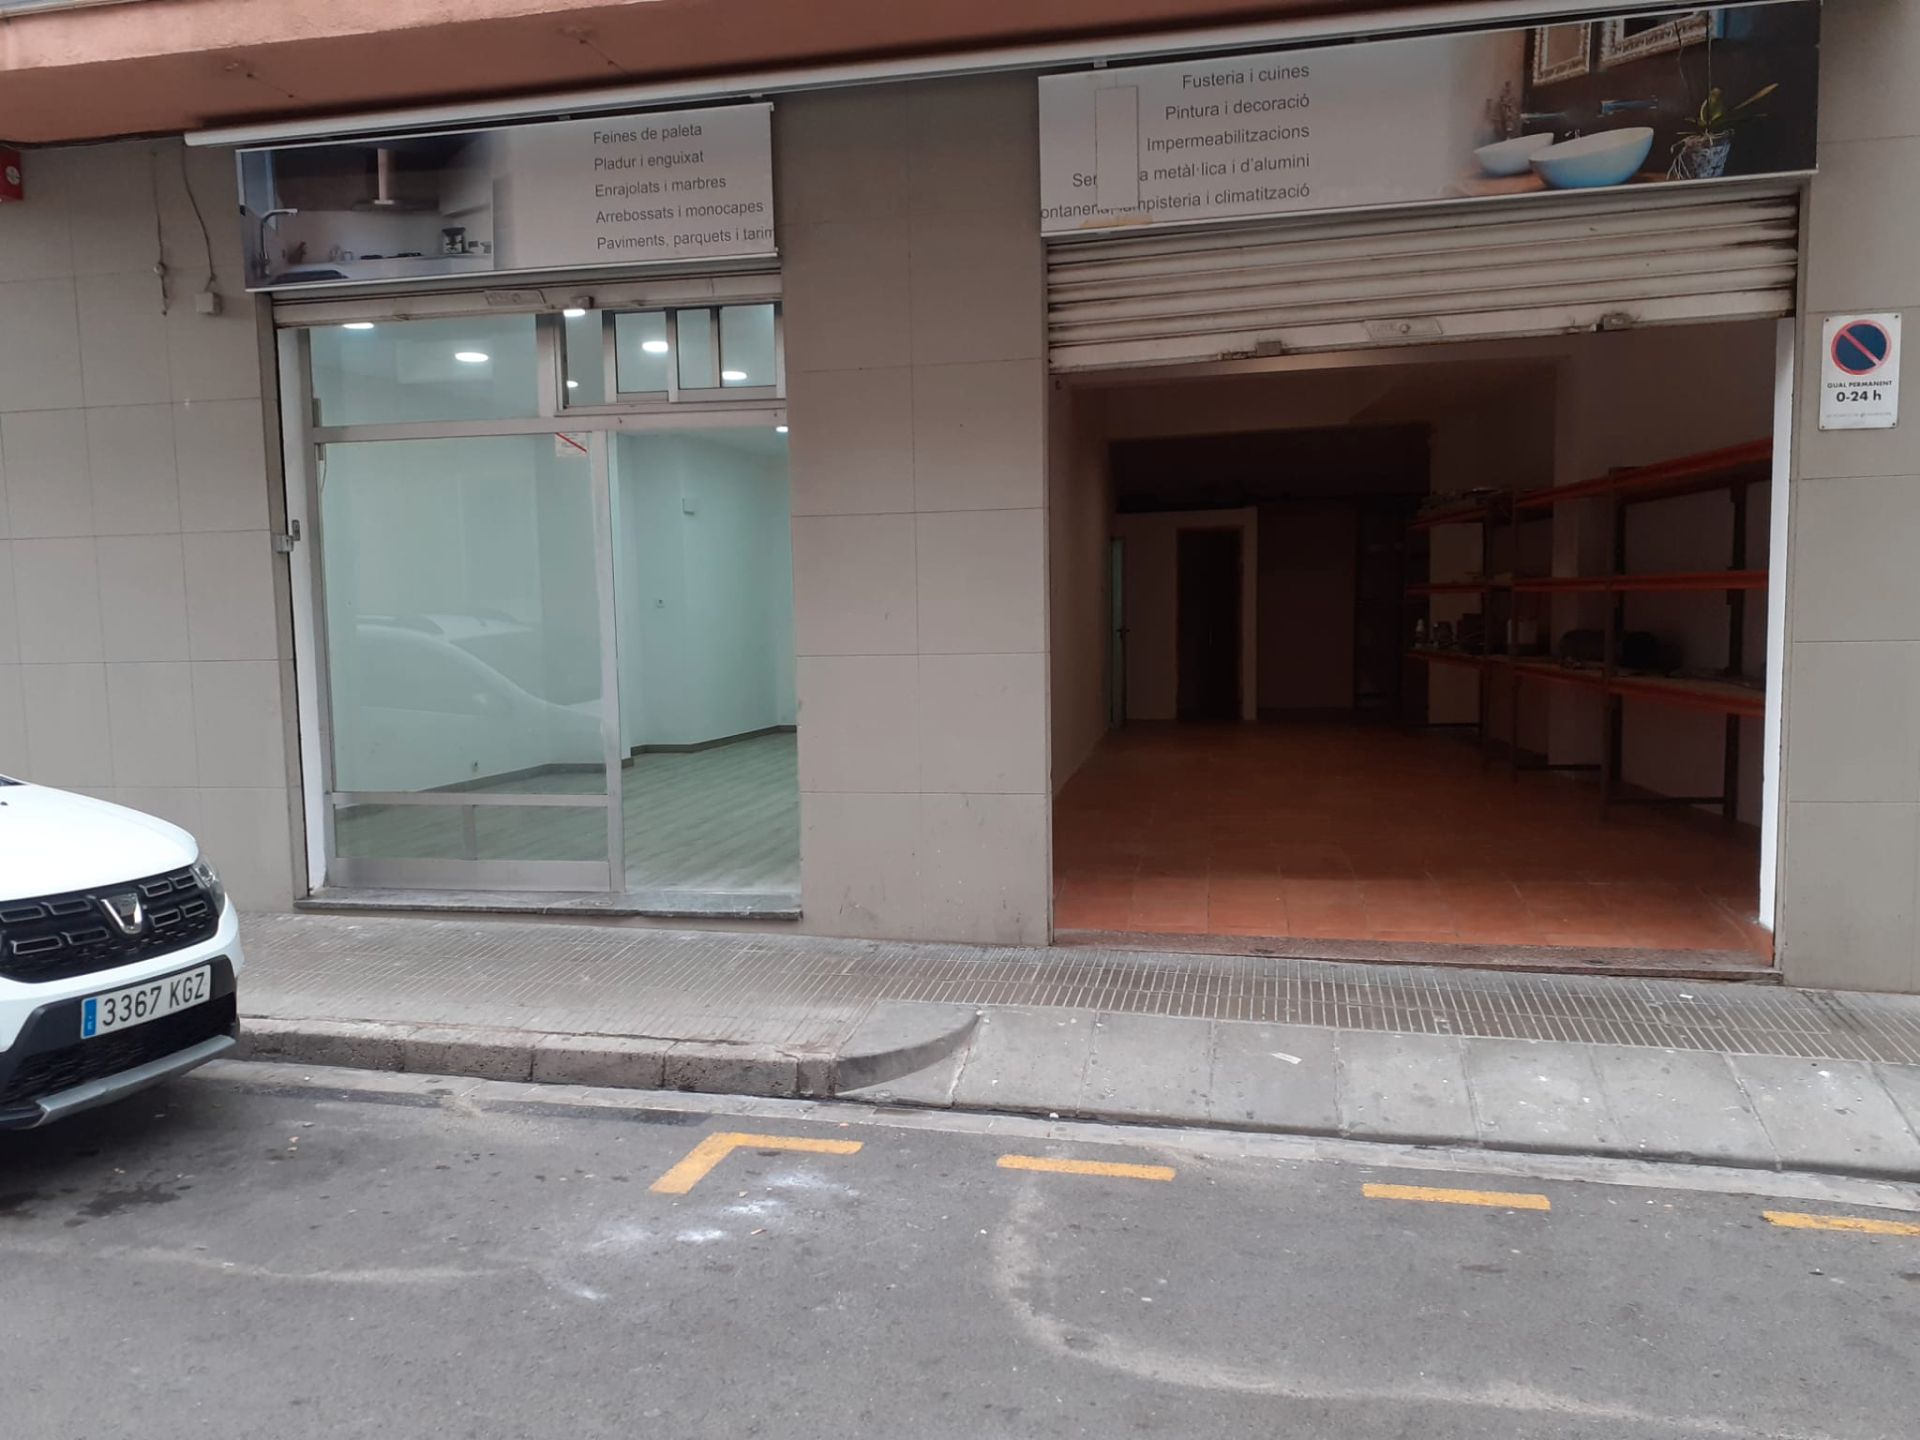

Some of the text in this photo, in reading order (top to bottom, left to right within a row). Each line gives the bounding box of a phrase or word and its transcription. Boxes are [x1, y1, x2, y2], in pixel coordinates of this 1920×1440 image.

[1182, 65, 1310, 89] Fusteria i cuines
[1165, 93, 1310, 120] Pintura i decoració
[593, 124, 702, 144] Feines de paleta
[1147, 125, 1310, 153] Impermeabilitzacions
[594, 151, 704, 171] Pladur i enguixat
[1232, 160, 1236, 174] i
[595, 177, 727, 199] Enrajolats i marbres
[1206, 190, 1210, 205] i
[1214, 183, 1310, 205] climatització
[596, 201, 764, 224] Arrebossats i monocapes
[597, 234, 669, 250] Paviments,
[673, 229, 732, 248] parquets
[735, 226, 739, 241] i
[1836, 389, 1882, 402] 0-24 h
[102, 972, 205, 1027] 3367 KGZ
